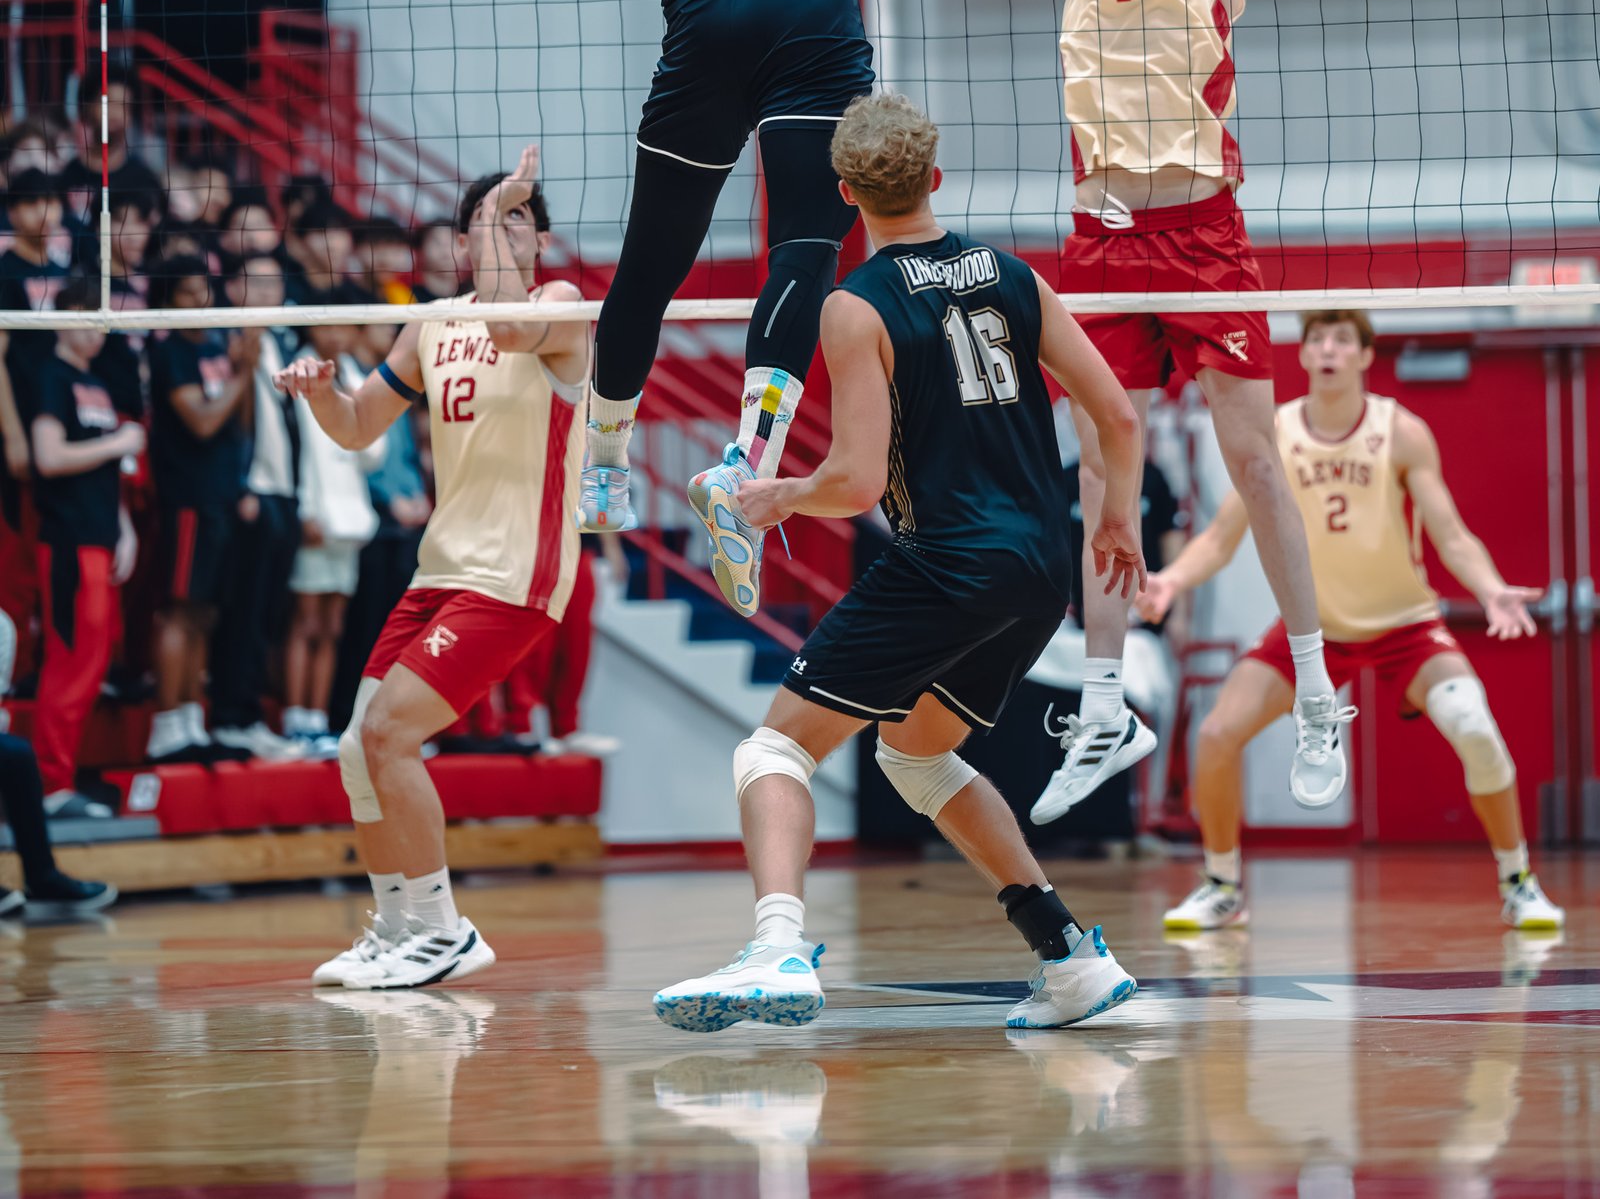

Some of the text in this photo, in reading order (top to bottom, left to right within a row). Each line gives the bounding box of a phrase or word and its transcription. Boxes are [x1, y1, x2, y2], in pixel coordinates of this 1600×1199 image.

[433, 336, 499, 368] LEWIS
[942, 304, 1019, 407] 16
[442, 377, 476, 423] 12
[1297, 461, 1371, 488] LEWIS
[1327, 494, 1348, 532] 2
